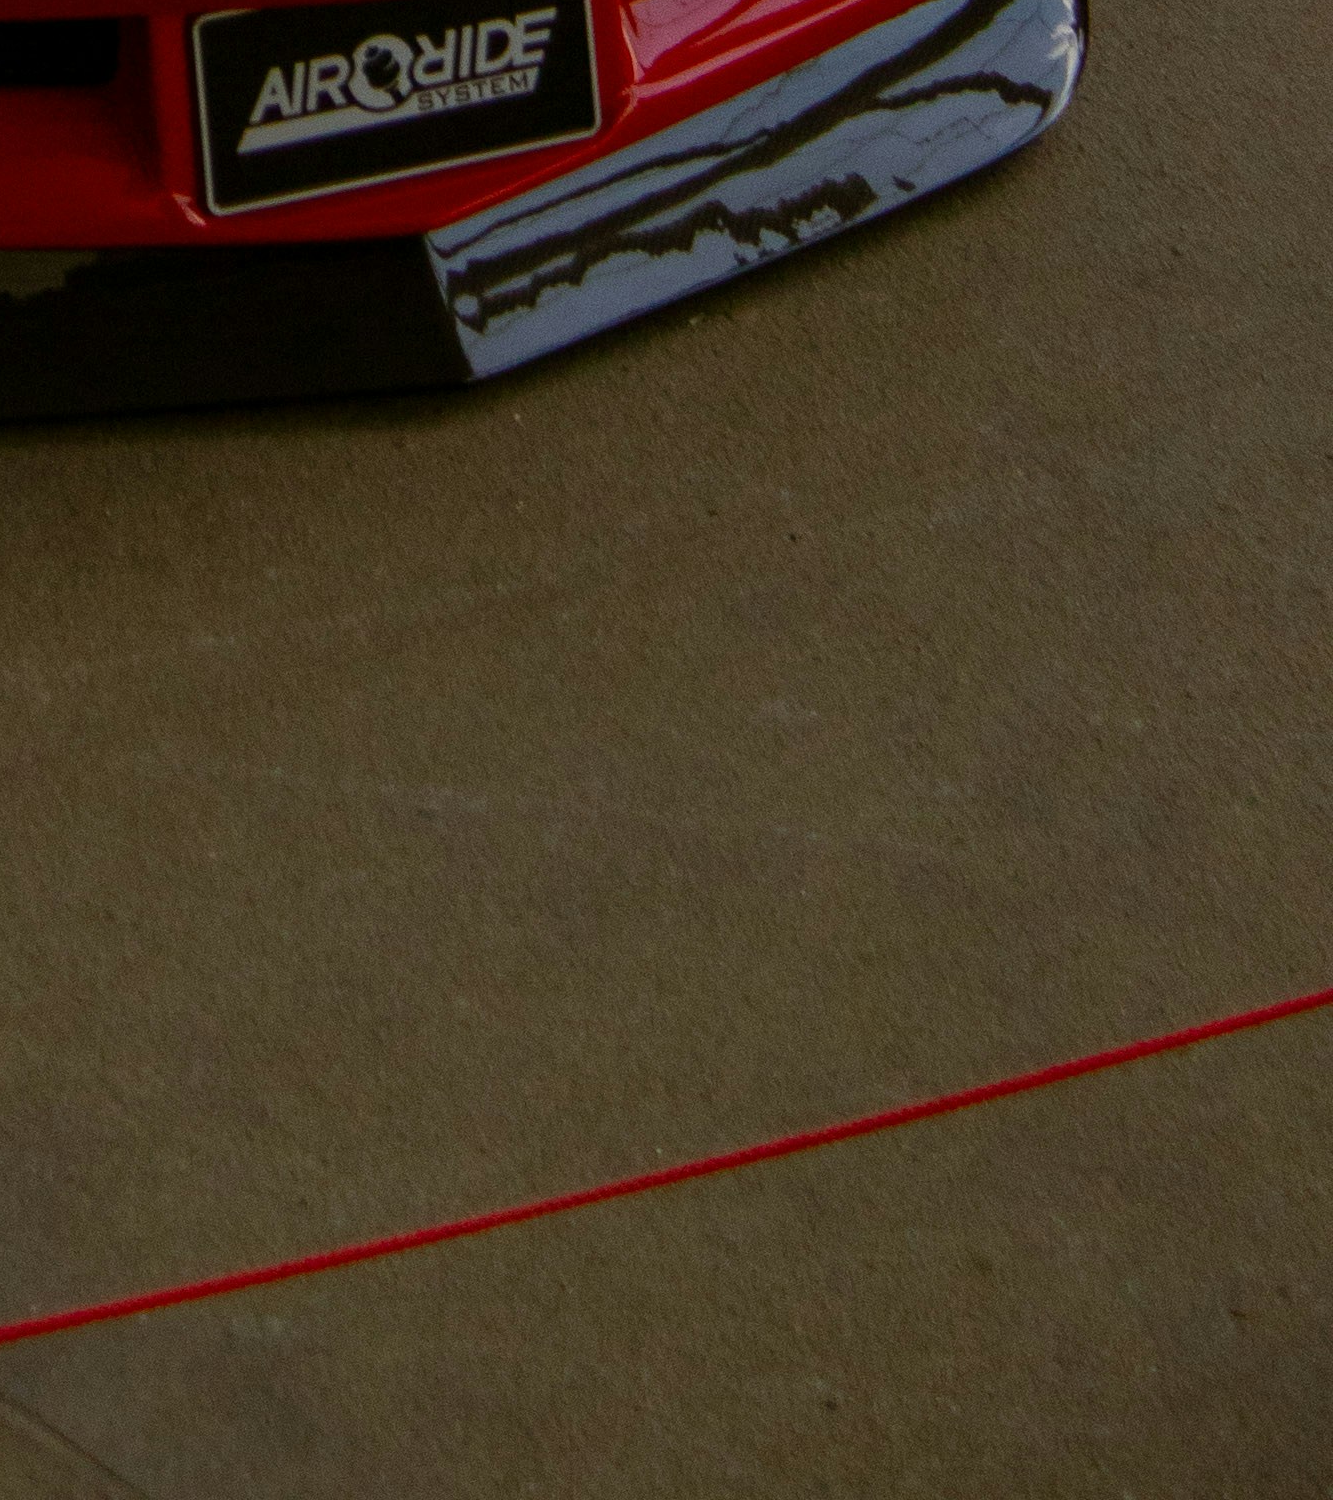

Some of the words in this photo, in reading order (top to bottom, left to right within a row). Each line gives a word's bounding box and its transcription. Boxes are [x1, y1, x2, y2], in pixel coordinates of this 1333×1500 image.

[248, 53, 350, 126] AIR
[413, 6, 558, 87] RIDE
[417, 72, 531, 112] SYSTEM
